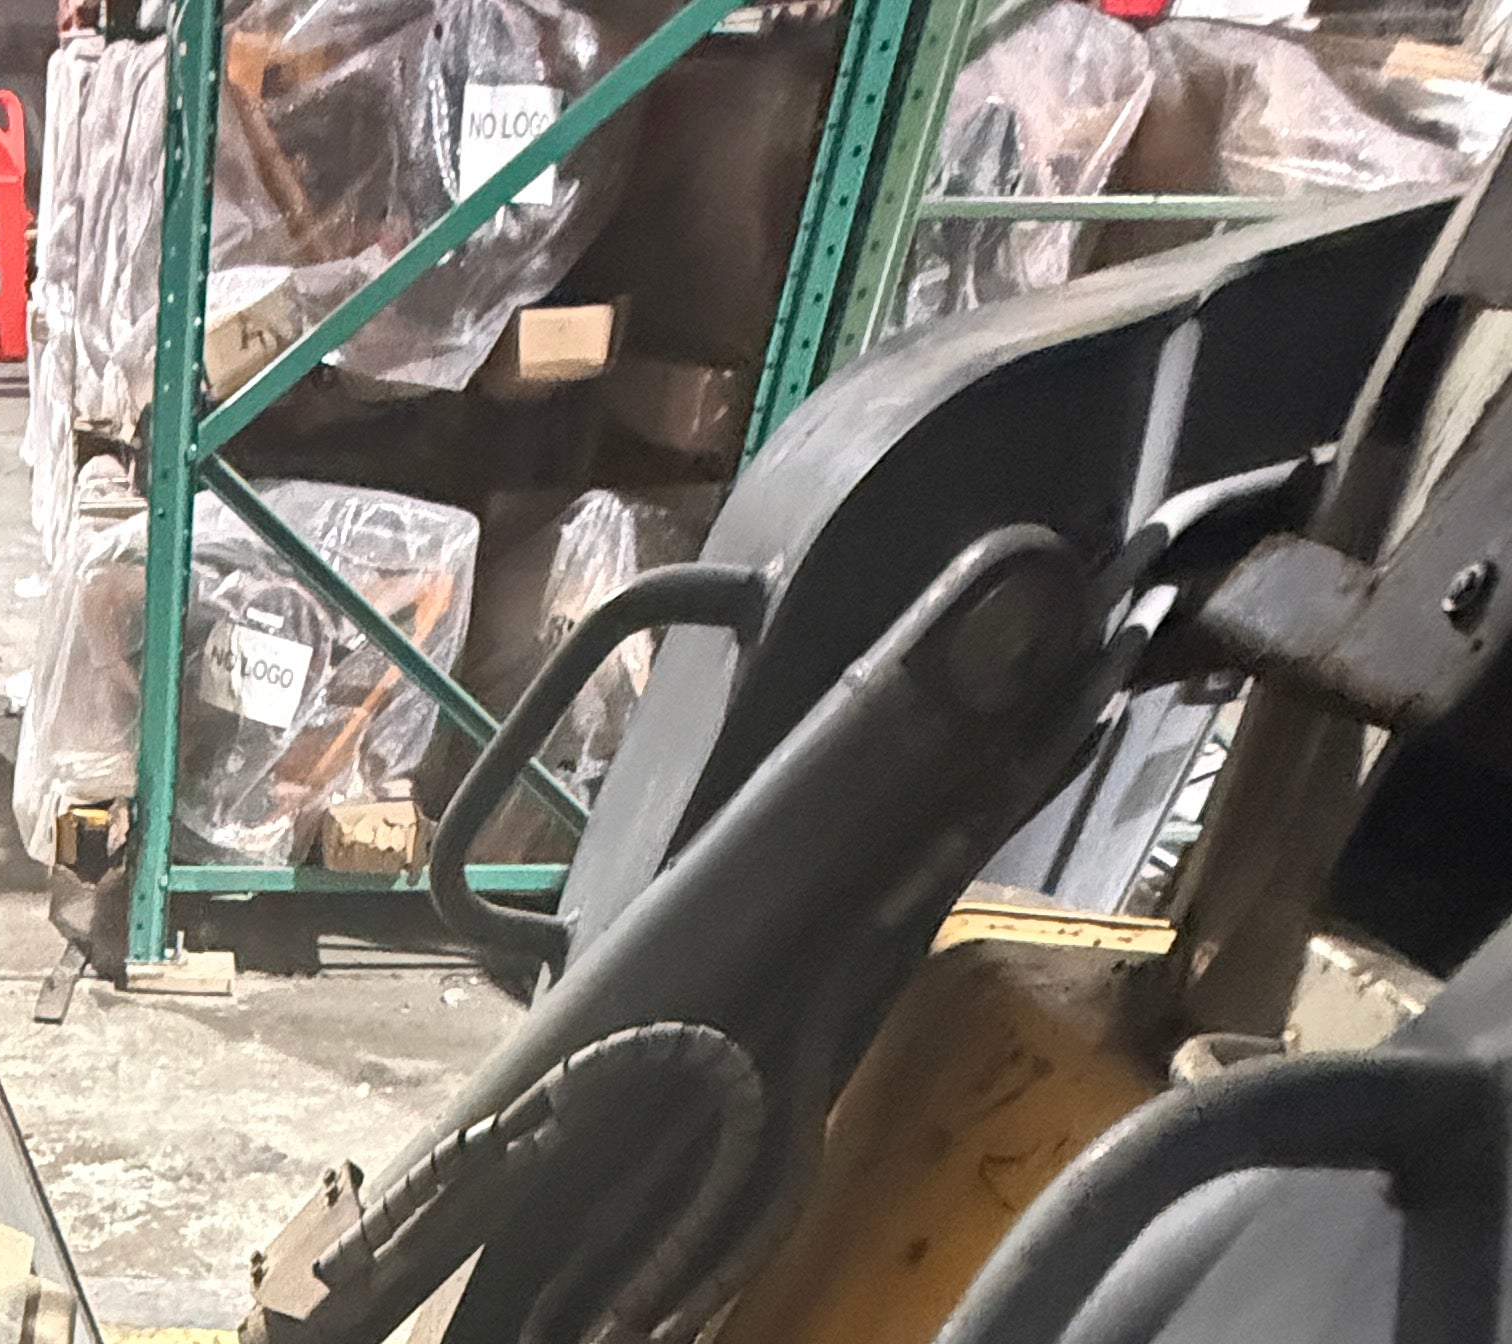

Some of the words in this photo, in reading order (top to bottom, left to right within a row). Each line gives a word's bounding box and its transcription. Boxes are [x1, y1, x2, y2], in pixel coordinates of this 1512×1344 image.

[469, 112, 497, 140] NO
[211, 645, 237, 672] NO
[240, 651, 294, 689] LOGO
